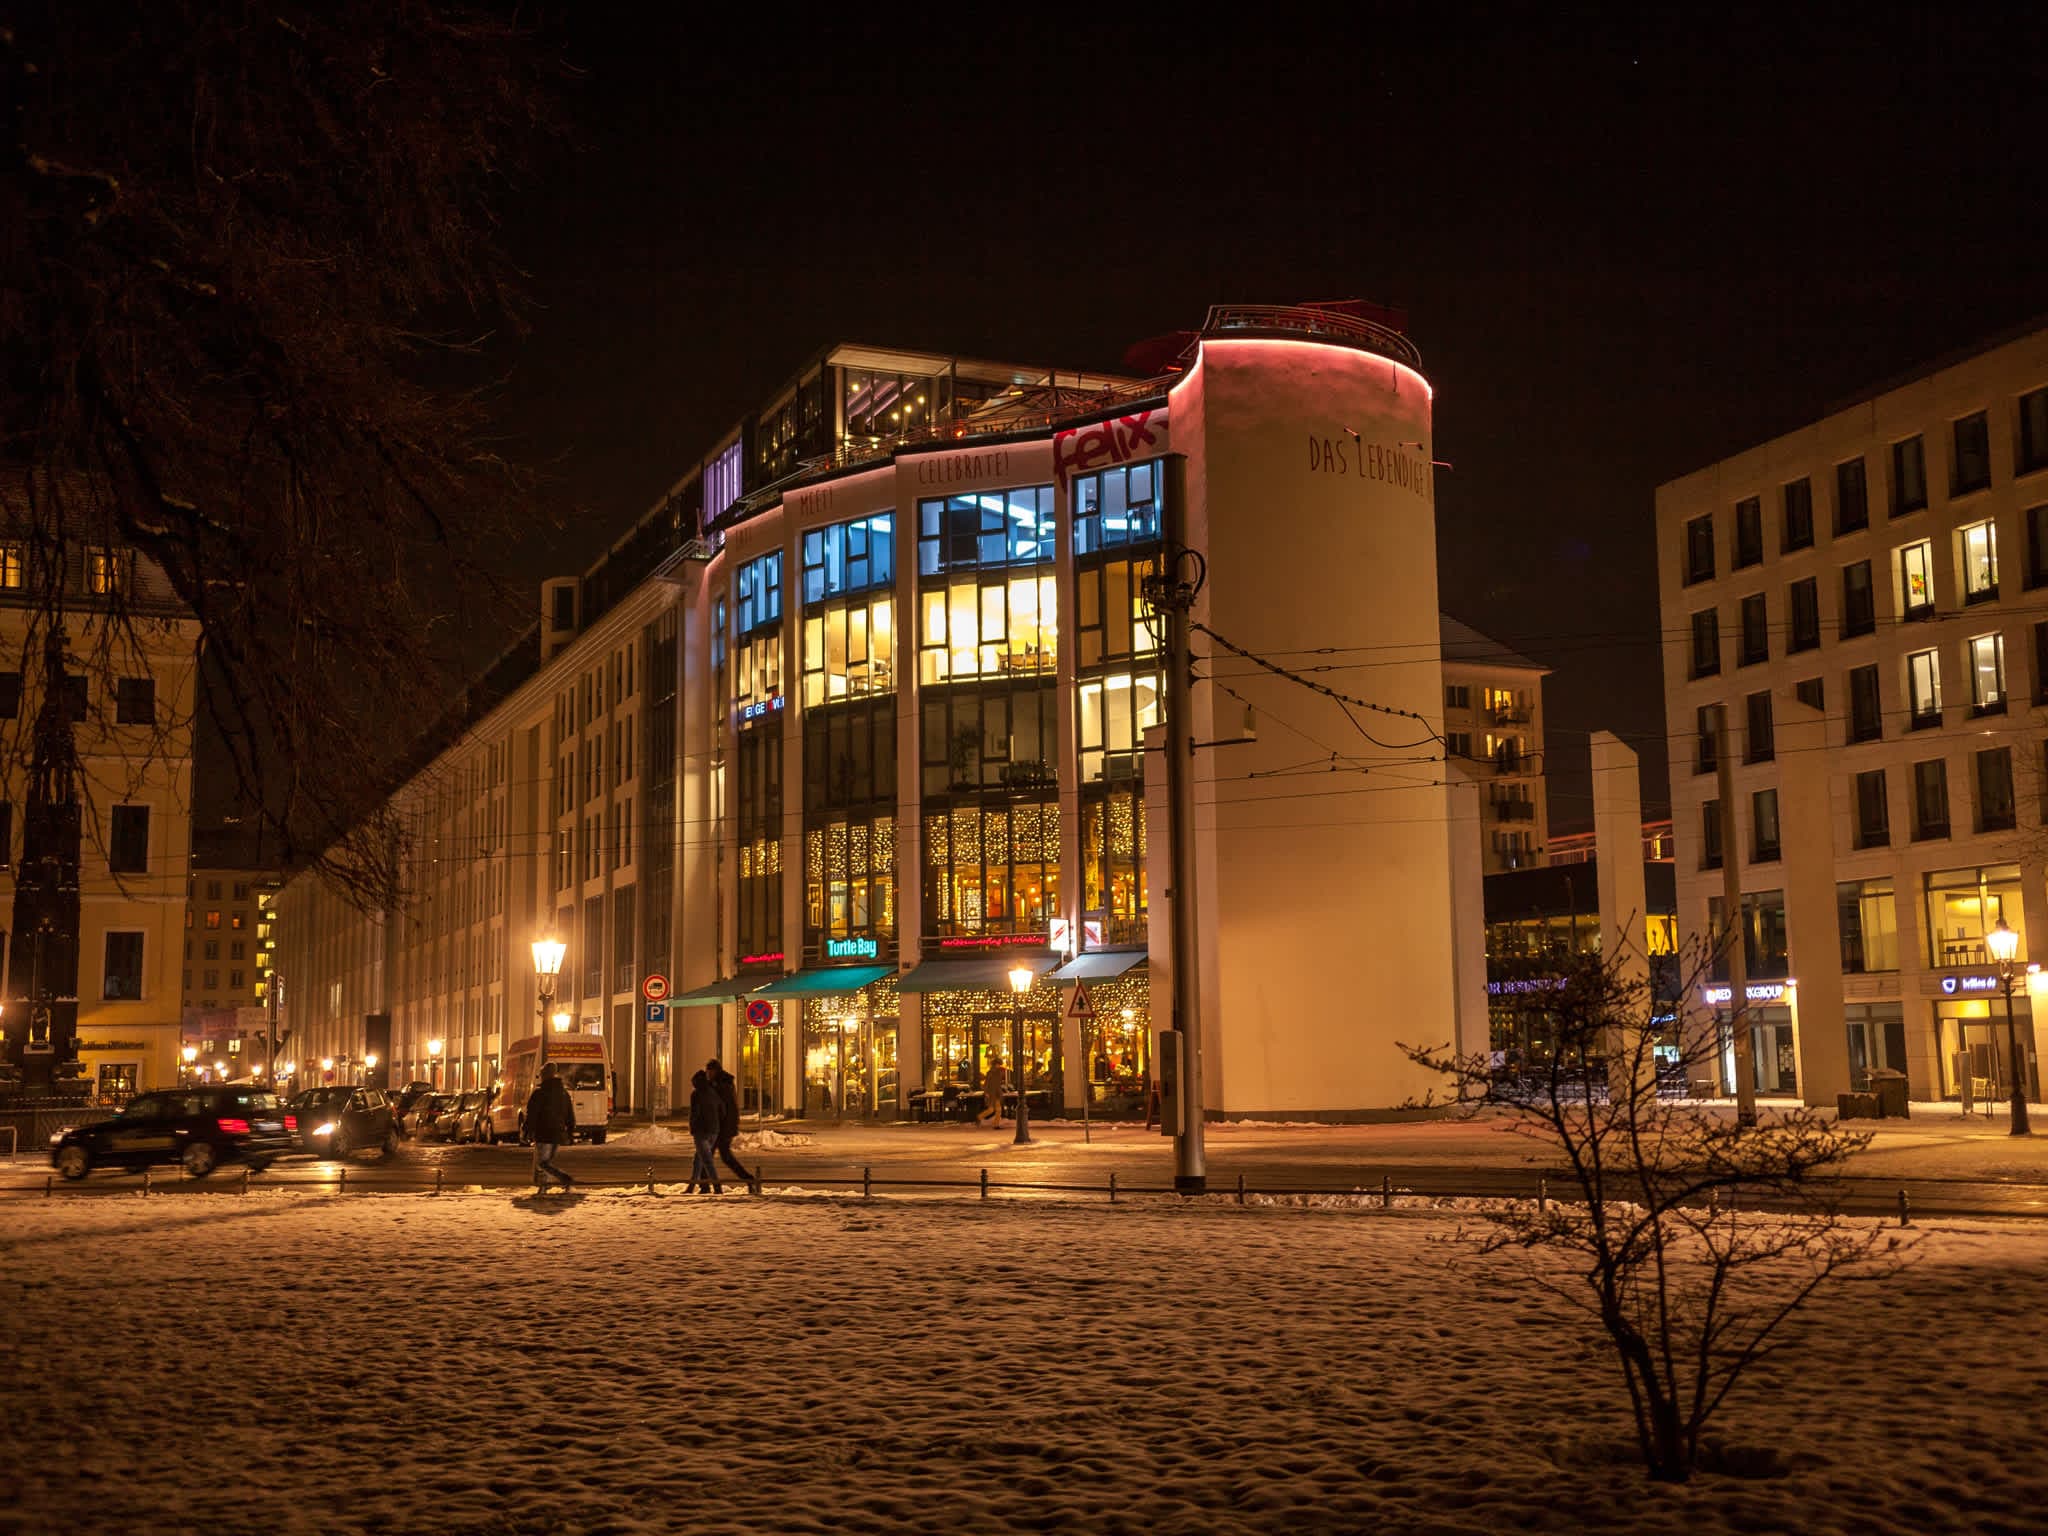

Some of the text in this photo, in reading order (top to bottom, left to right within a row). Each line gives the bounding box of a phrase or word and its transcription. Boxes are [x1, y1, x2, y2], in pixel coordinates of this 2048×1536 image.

[918, 450, 1009, 485] CELEBRATE!
[1309, 435, 1348, 474] DAS
[827, 937, 877, 958] Turtle Bay
